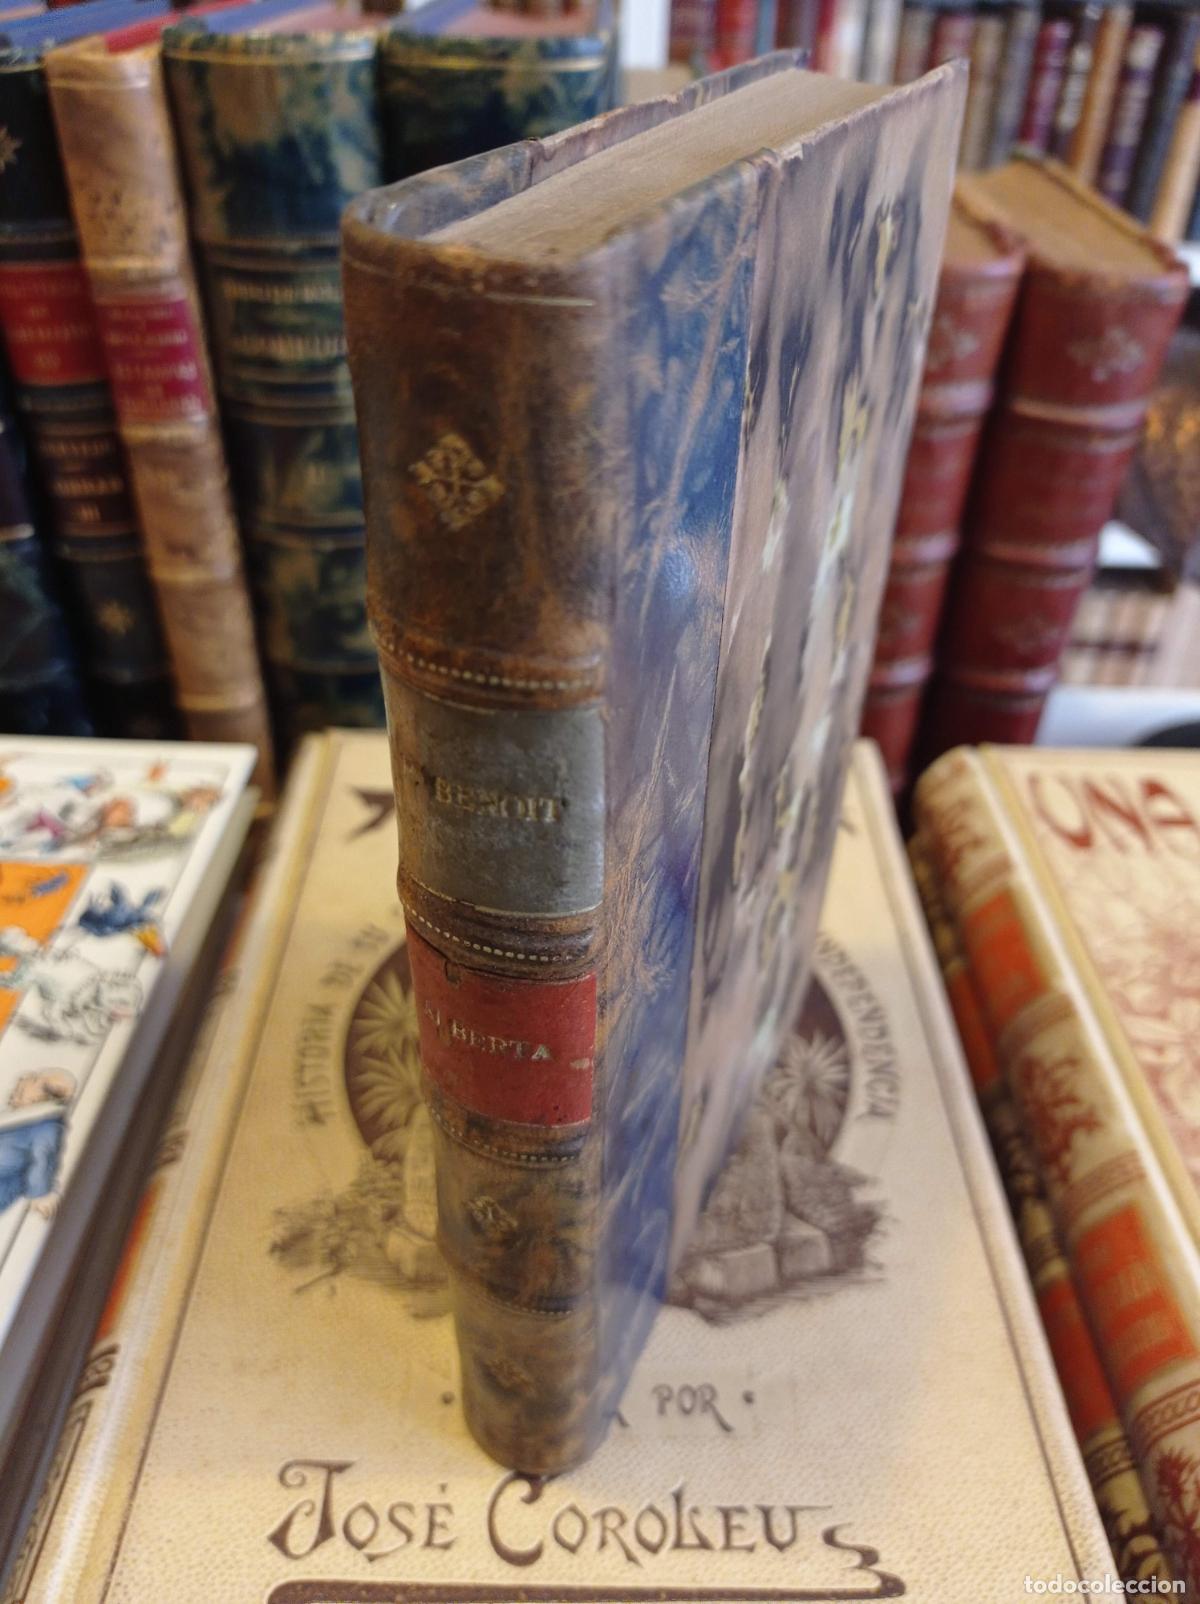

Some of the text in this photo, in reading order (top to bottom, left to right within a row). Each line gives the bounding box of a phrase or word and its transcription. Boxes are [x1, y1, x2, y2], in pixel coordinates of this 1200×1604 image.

[435, 776, 562, 824] BENOIT
[815, 930, 899, 1121] NDEPENDENCIA
[651, 1382, 735, 1433] POR
